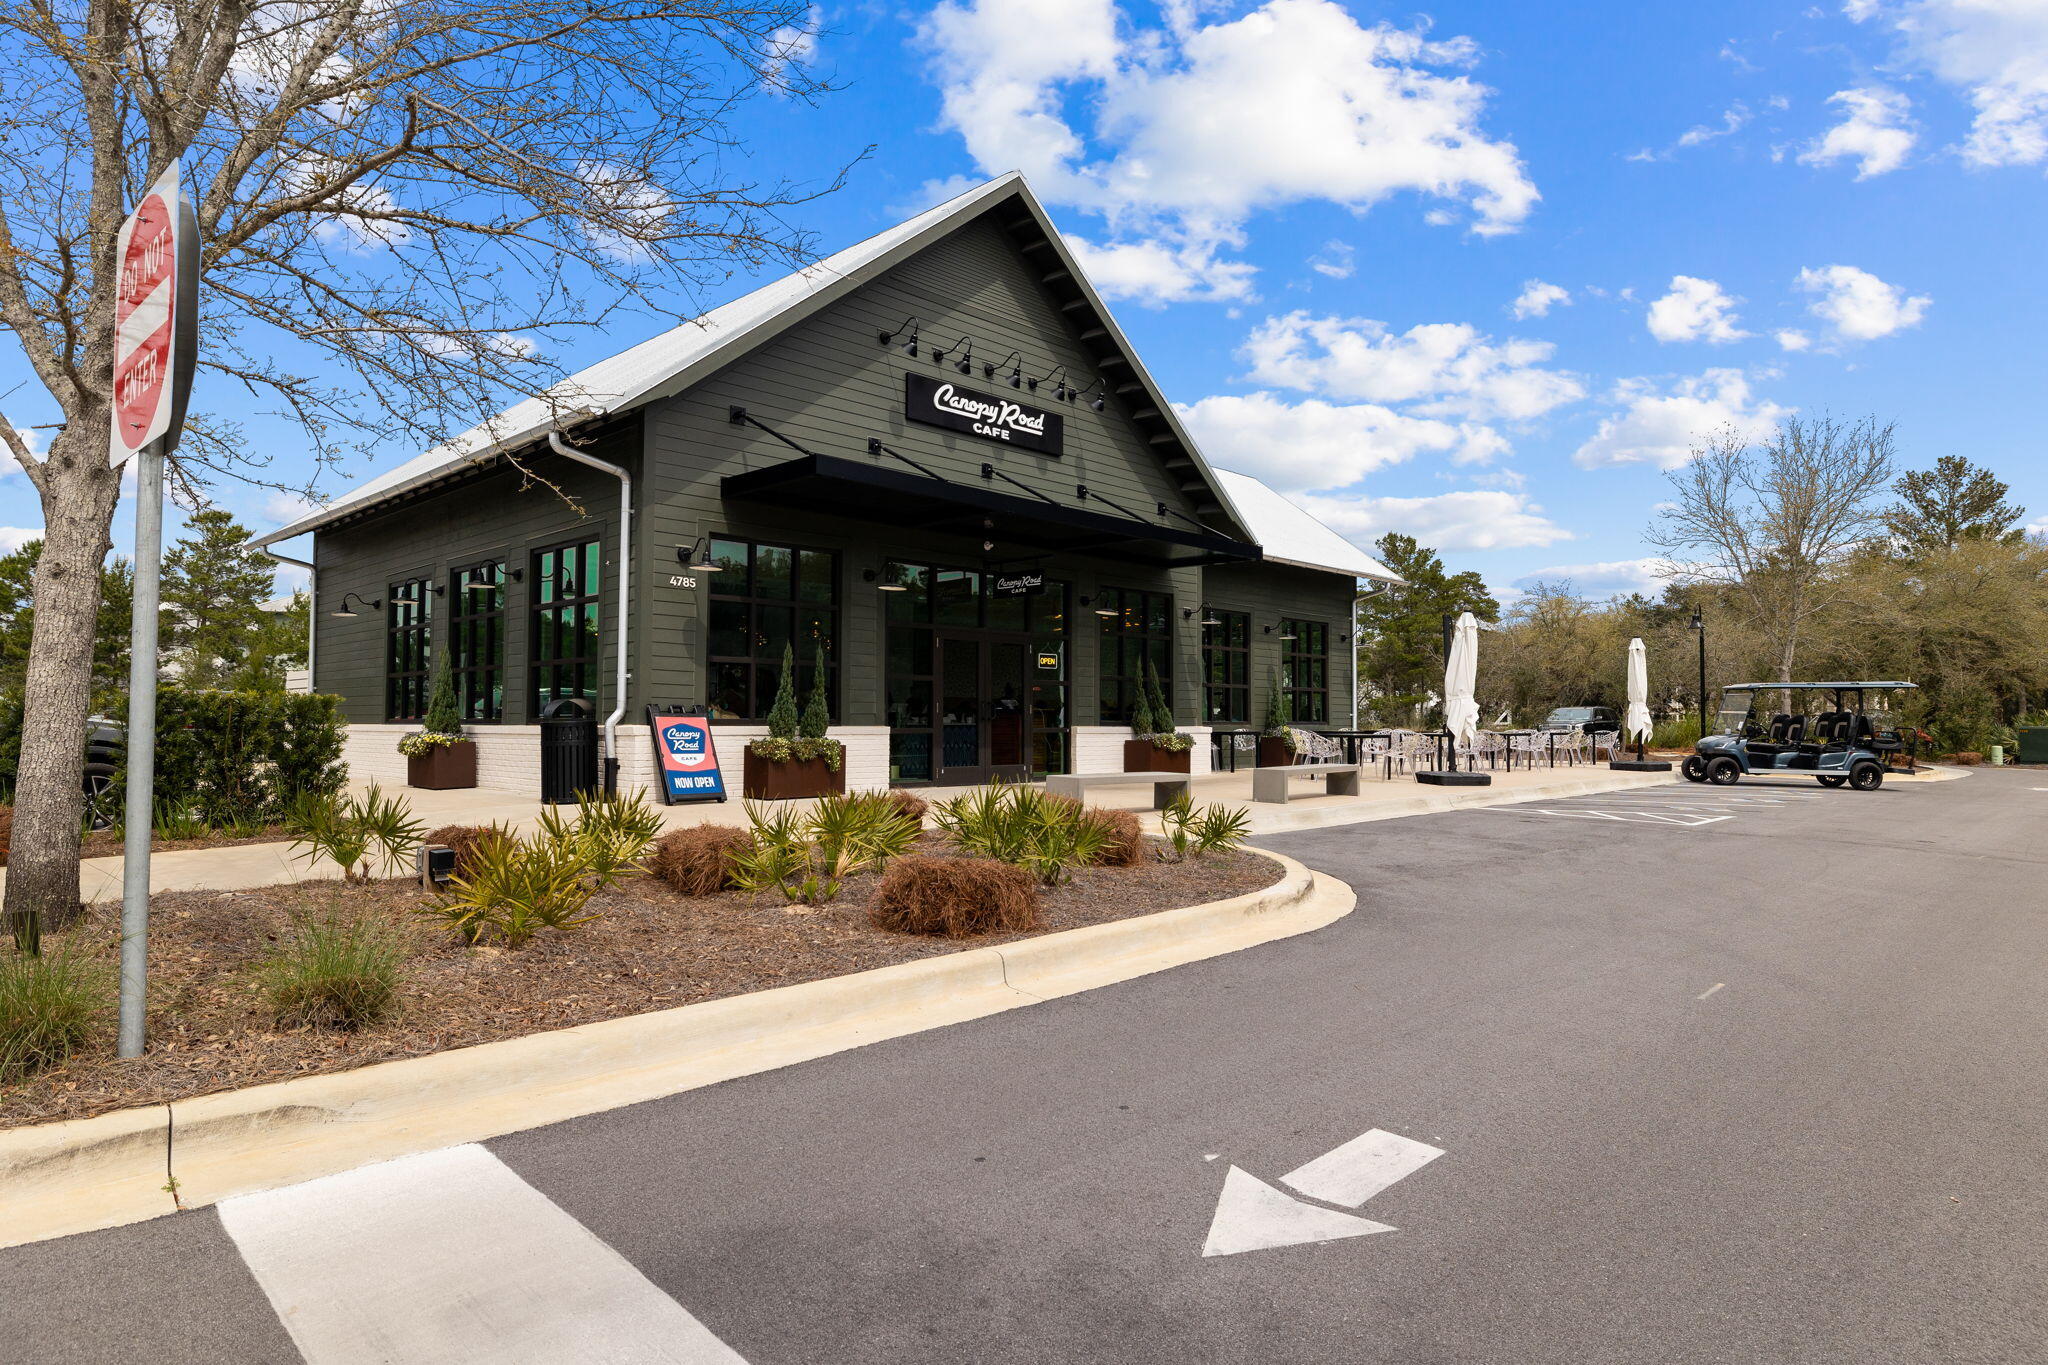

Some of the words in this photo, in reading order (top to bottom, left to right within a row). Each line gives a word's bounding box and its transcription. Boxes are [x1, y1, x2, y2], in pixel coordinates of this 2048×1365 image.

[123, 260, 138, 304] DO
[144, 226, 168, 283] NOT
[123, 348, 158, 408] ENTER
[933, 383, 999, 423] Canopy
[997, 400, 1045, 436] Road
[973, 423, 1010, 440] CAFE
[669, 576, 696, 588] 4785
[997, 578, 1022, 590] Canopy
[1021, 574, 1042, 587] Road
[1040, 657, 1056, 665] OPEN
[667, 727, 701, 740] Canopy
[673, 739, 700, 751] Road
[674, 777, 693, 788] NOW
[694, 776, 715, 787] OPEN
